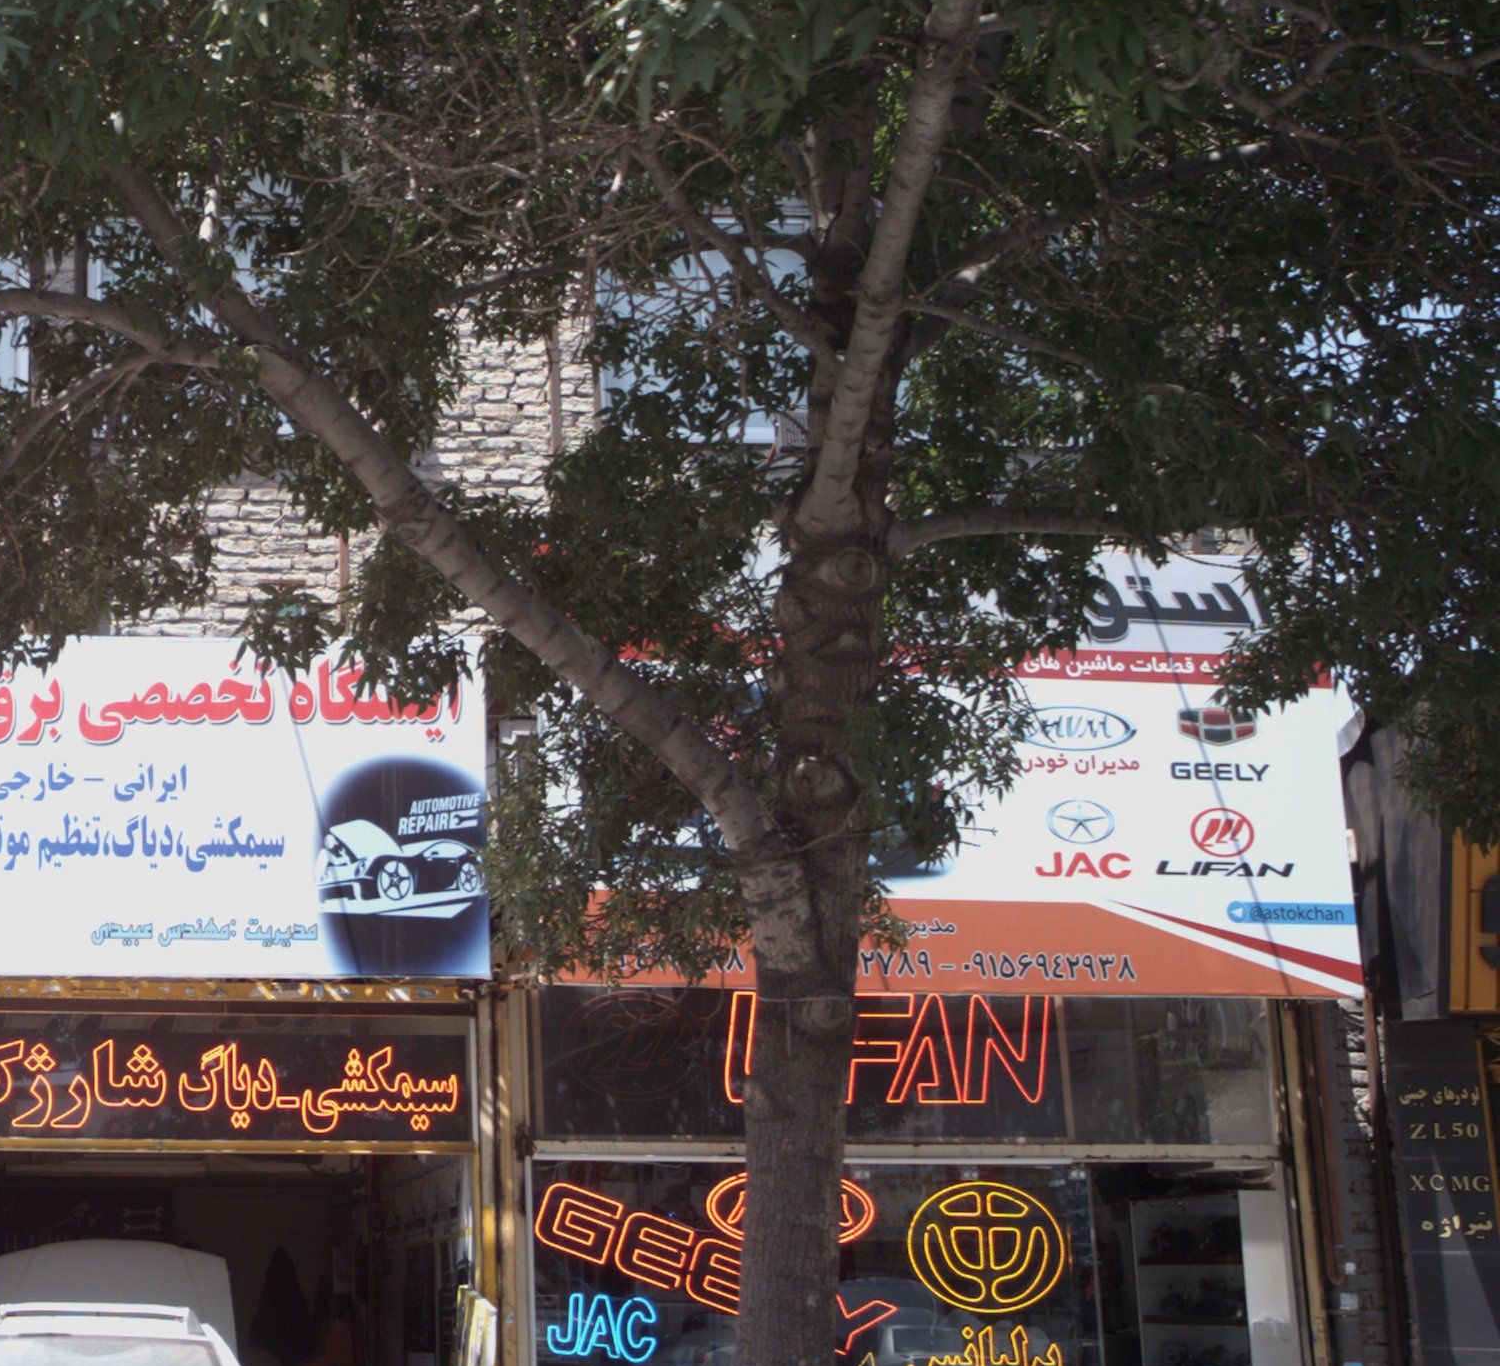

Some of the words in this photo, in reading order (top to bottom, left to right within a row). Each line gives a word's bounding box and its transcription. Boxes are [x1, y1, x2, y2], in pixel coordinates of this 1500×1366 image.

[1023, 652, 1061, 673] های
[1065, 654, 1125, 677] ماشین
[1130, 656, 1196, 674] قطعات
[78, 657, 275, 743] تخصصی
[1075, 755, 1140, 775] مدیران
[1171, 762, 1270, 783] GEELY
[113, 763, 188, 803] ایرانی
[409, 793, 480, 815] AUTOMOTIVE
[398, 812, 449, 835] REPAIR
[1035, 851, 1132, 879] JAC
[1156, 860, 1295, 878] LIFAN
[1249, 903, 1345, 922] @astokchan
[725, 991, 1050, 1104] LFAN
[12, 1037, 166, 1129] شارژ
[1410, 1175, 1490, 1191] XCMG
[535, 1182, 899, 1356] GEEY
[547, 1292, 657, 1364] JAC
